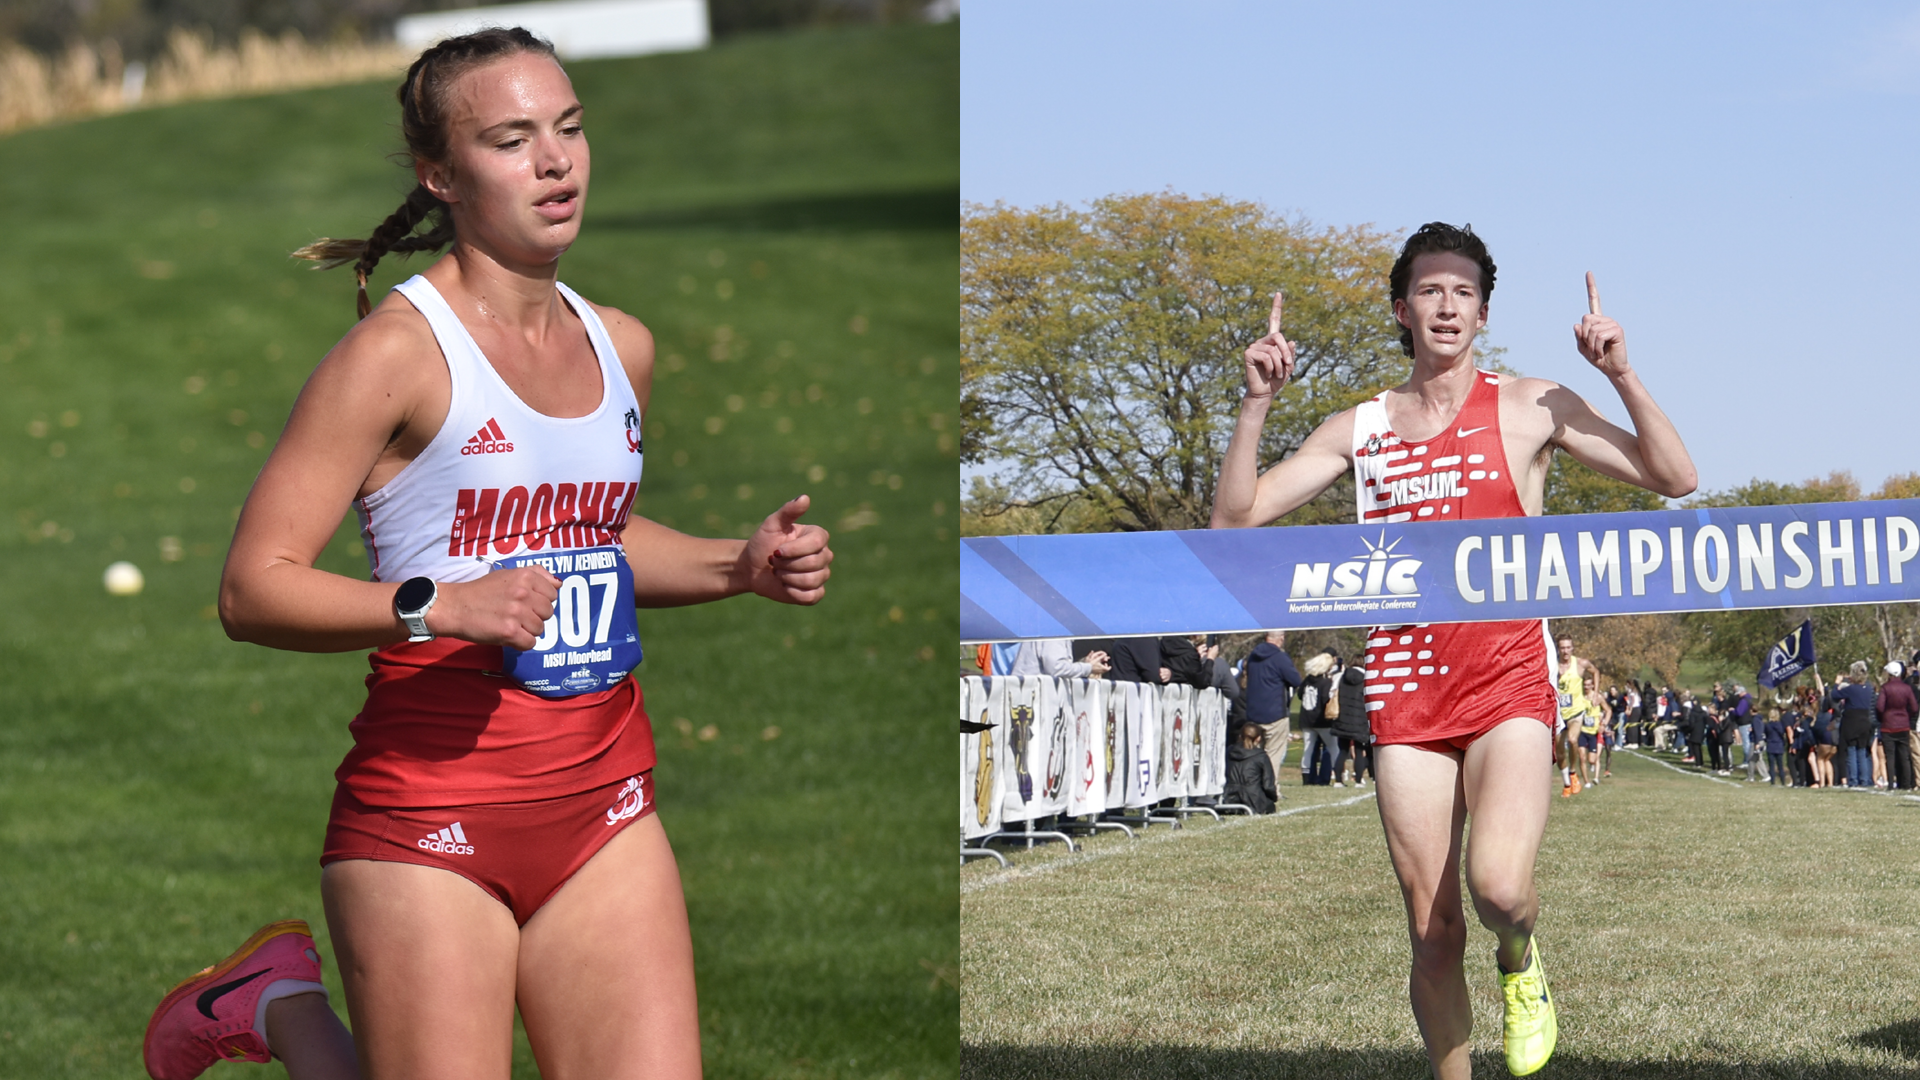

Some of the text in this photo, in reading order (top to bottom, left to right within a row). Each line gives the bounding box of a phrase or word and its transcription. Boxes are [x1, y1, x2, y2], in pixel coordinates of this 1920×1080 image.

[460, 440, 514, 455] adidas
[1390, 470, 1458, 507] MSUM
[448, 481, 638, 557] MOORHEA
[453, 508, 466, 538] MSU
[575, 551, 617, 571] KENNEDY
[1454, 516, 1919, 604] CHAMPIONSHIP
[1288, 558, 1423, 599] NSIC
[1288, 599, 1417, 613] Northern Sun Intercollegiate Conference
[543, 647, 612, 668] MSU Moorhead
[1768, 626, 1802, 673] AU
[526, 684, 561, 692] TimeToShine
[418, 837, 475, 855] adidas
